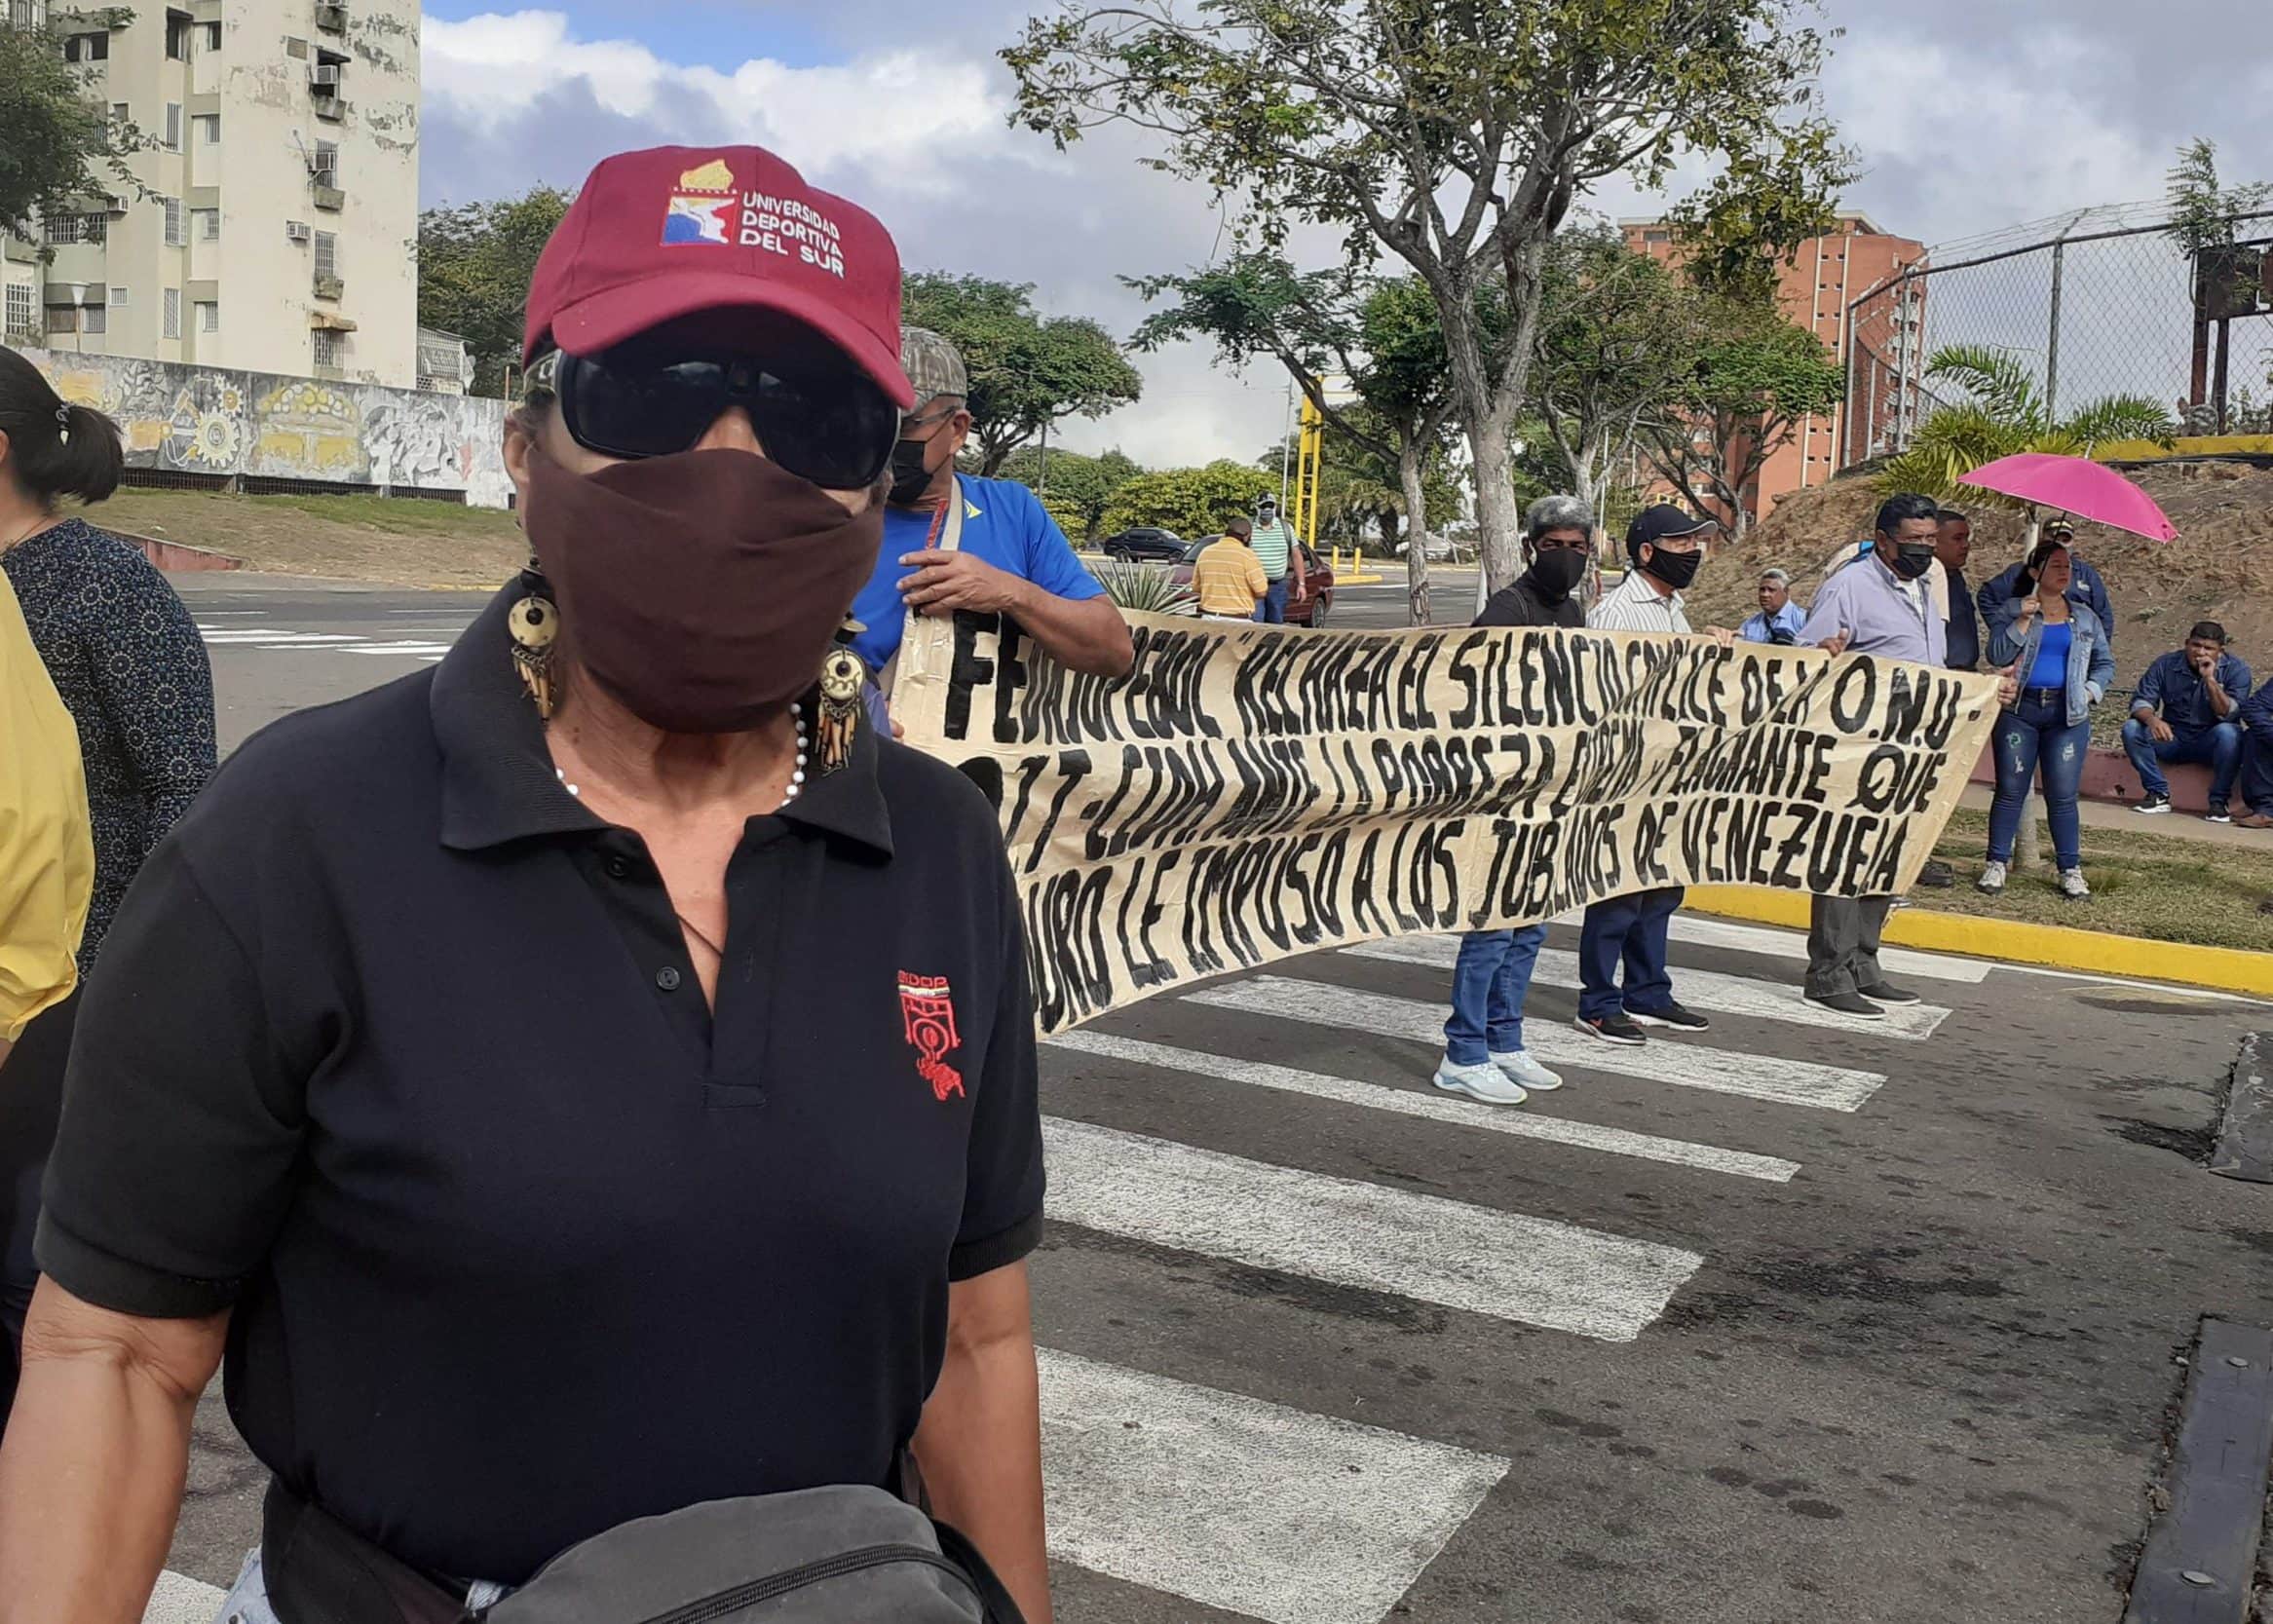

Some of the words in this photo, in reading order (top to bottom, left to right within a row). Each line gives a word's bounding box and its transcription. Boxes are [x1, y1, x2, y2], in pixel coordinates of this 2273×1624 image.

[741, 209, 844, 259] DEPORTIVA
[742, 191, 841, 241] UNIVERSIDAD
[739, 228, 788, 255] DEL
[800, 245, 844, 279] SUR
[1397, 633, 1448, 730] EL
[1449, 629, 1624, 729] SILENCIO
[1845, 743, 1948, 814] QUE
[1117, 850, 1179, 991] LE
[1182, 826, 1351, 976] IMPUSO
[1351, 827, 1392, 937] A
[1387, 820, 1466, 931] LOS
[1633, 799, 1682, 888] DE
[1681, 796, 1911, 896] VENEZUELA
